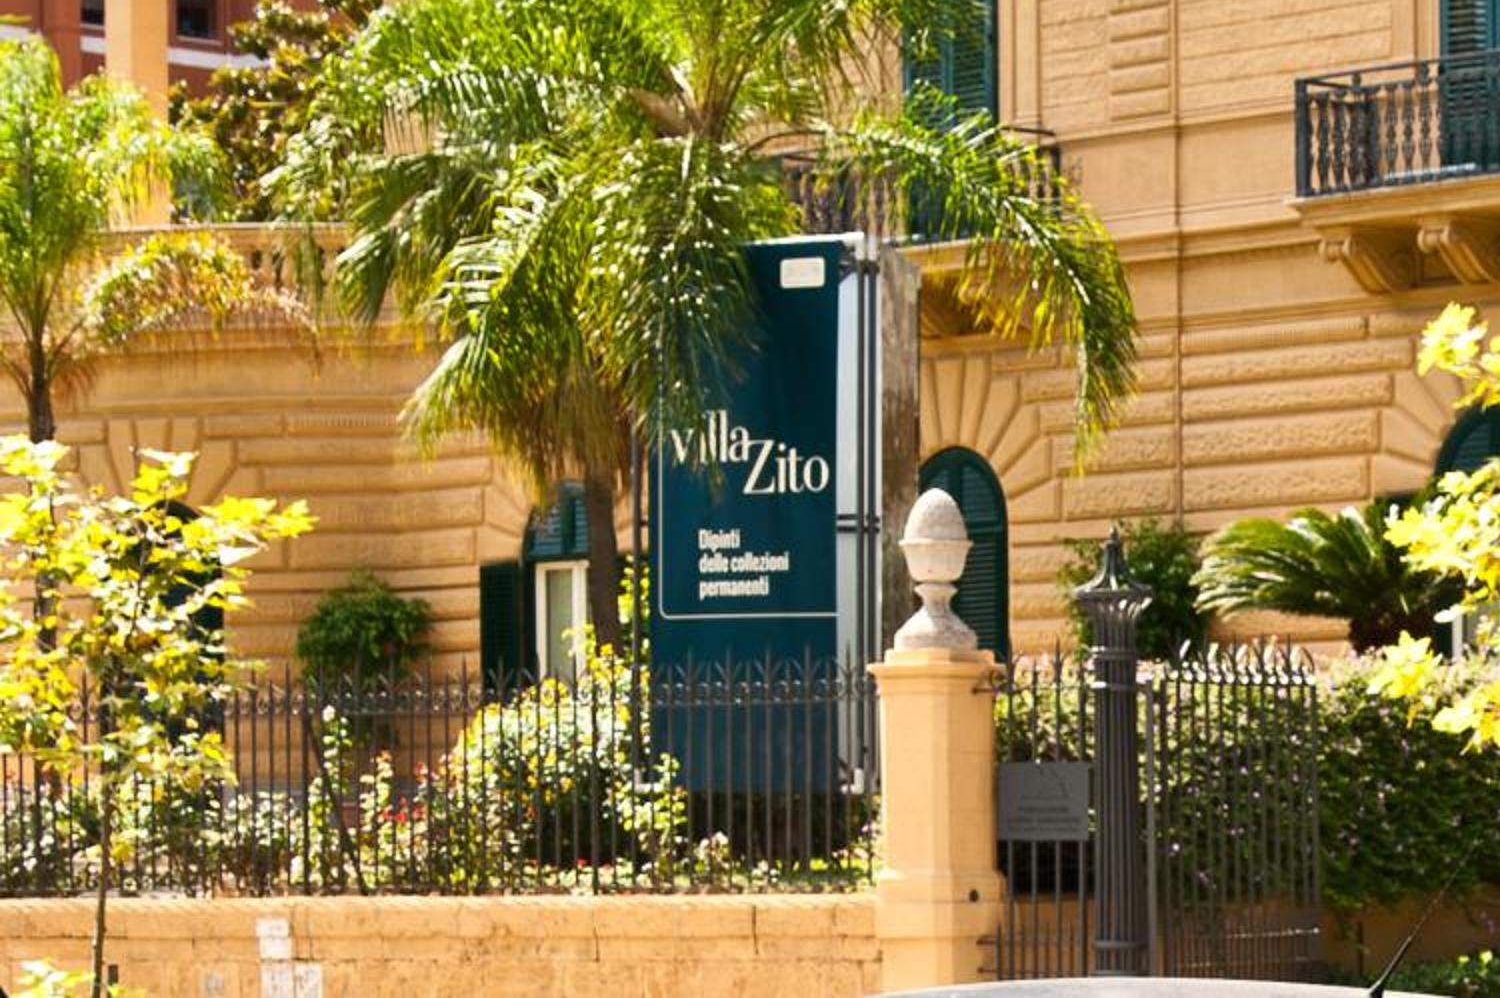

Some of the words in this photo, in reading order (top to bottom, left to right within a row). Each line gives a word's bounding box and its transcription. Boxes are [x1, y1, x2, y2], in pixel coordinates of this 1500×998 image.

[698, 529, 740, 551] Dipinti
[698, 553, 729, 573] delle
[730, 551, 790, 571] collezioni
[698, 575, 769, 601] permanenti
